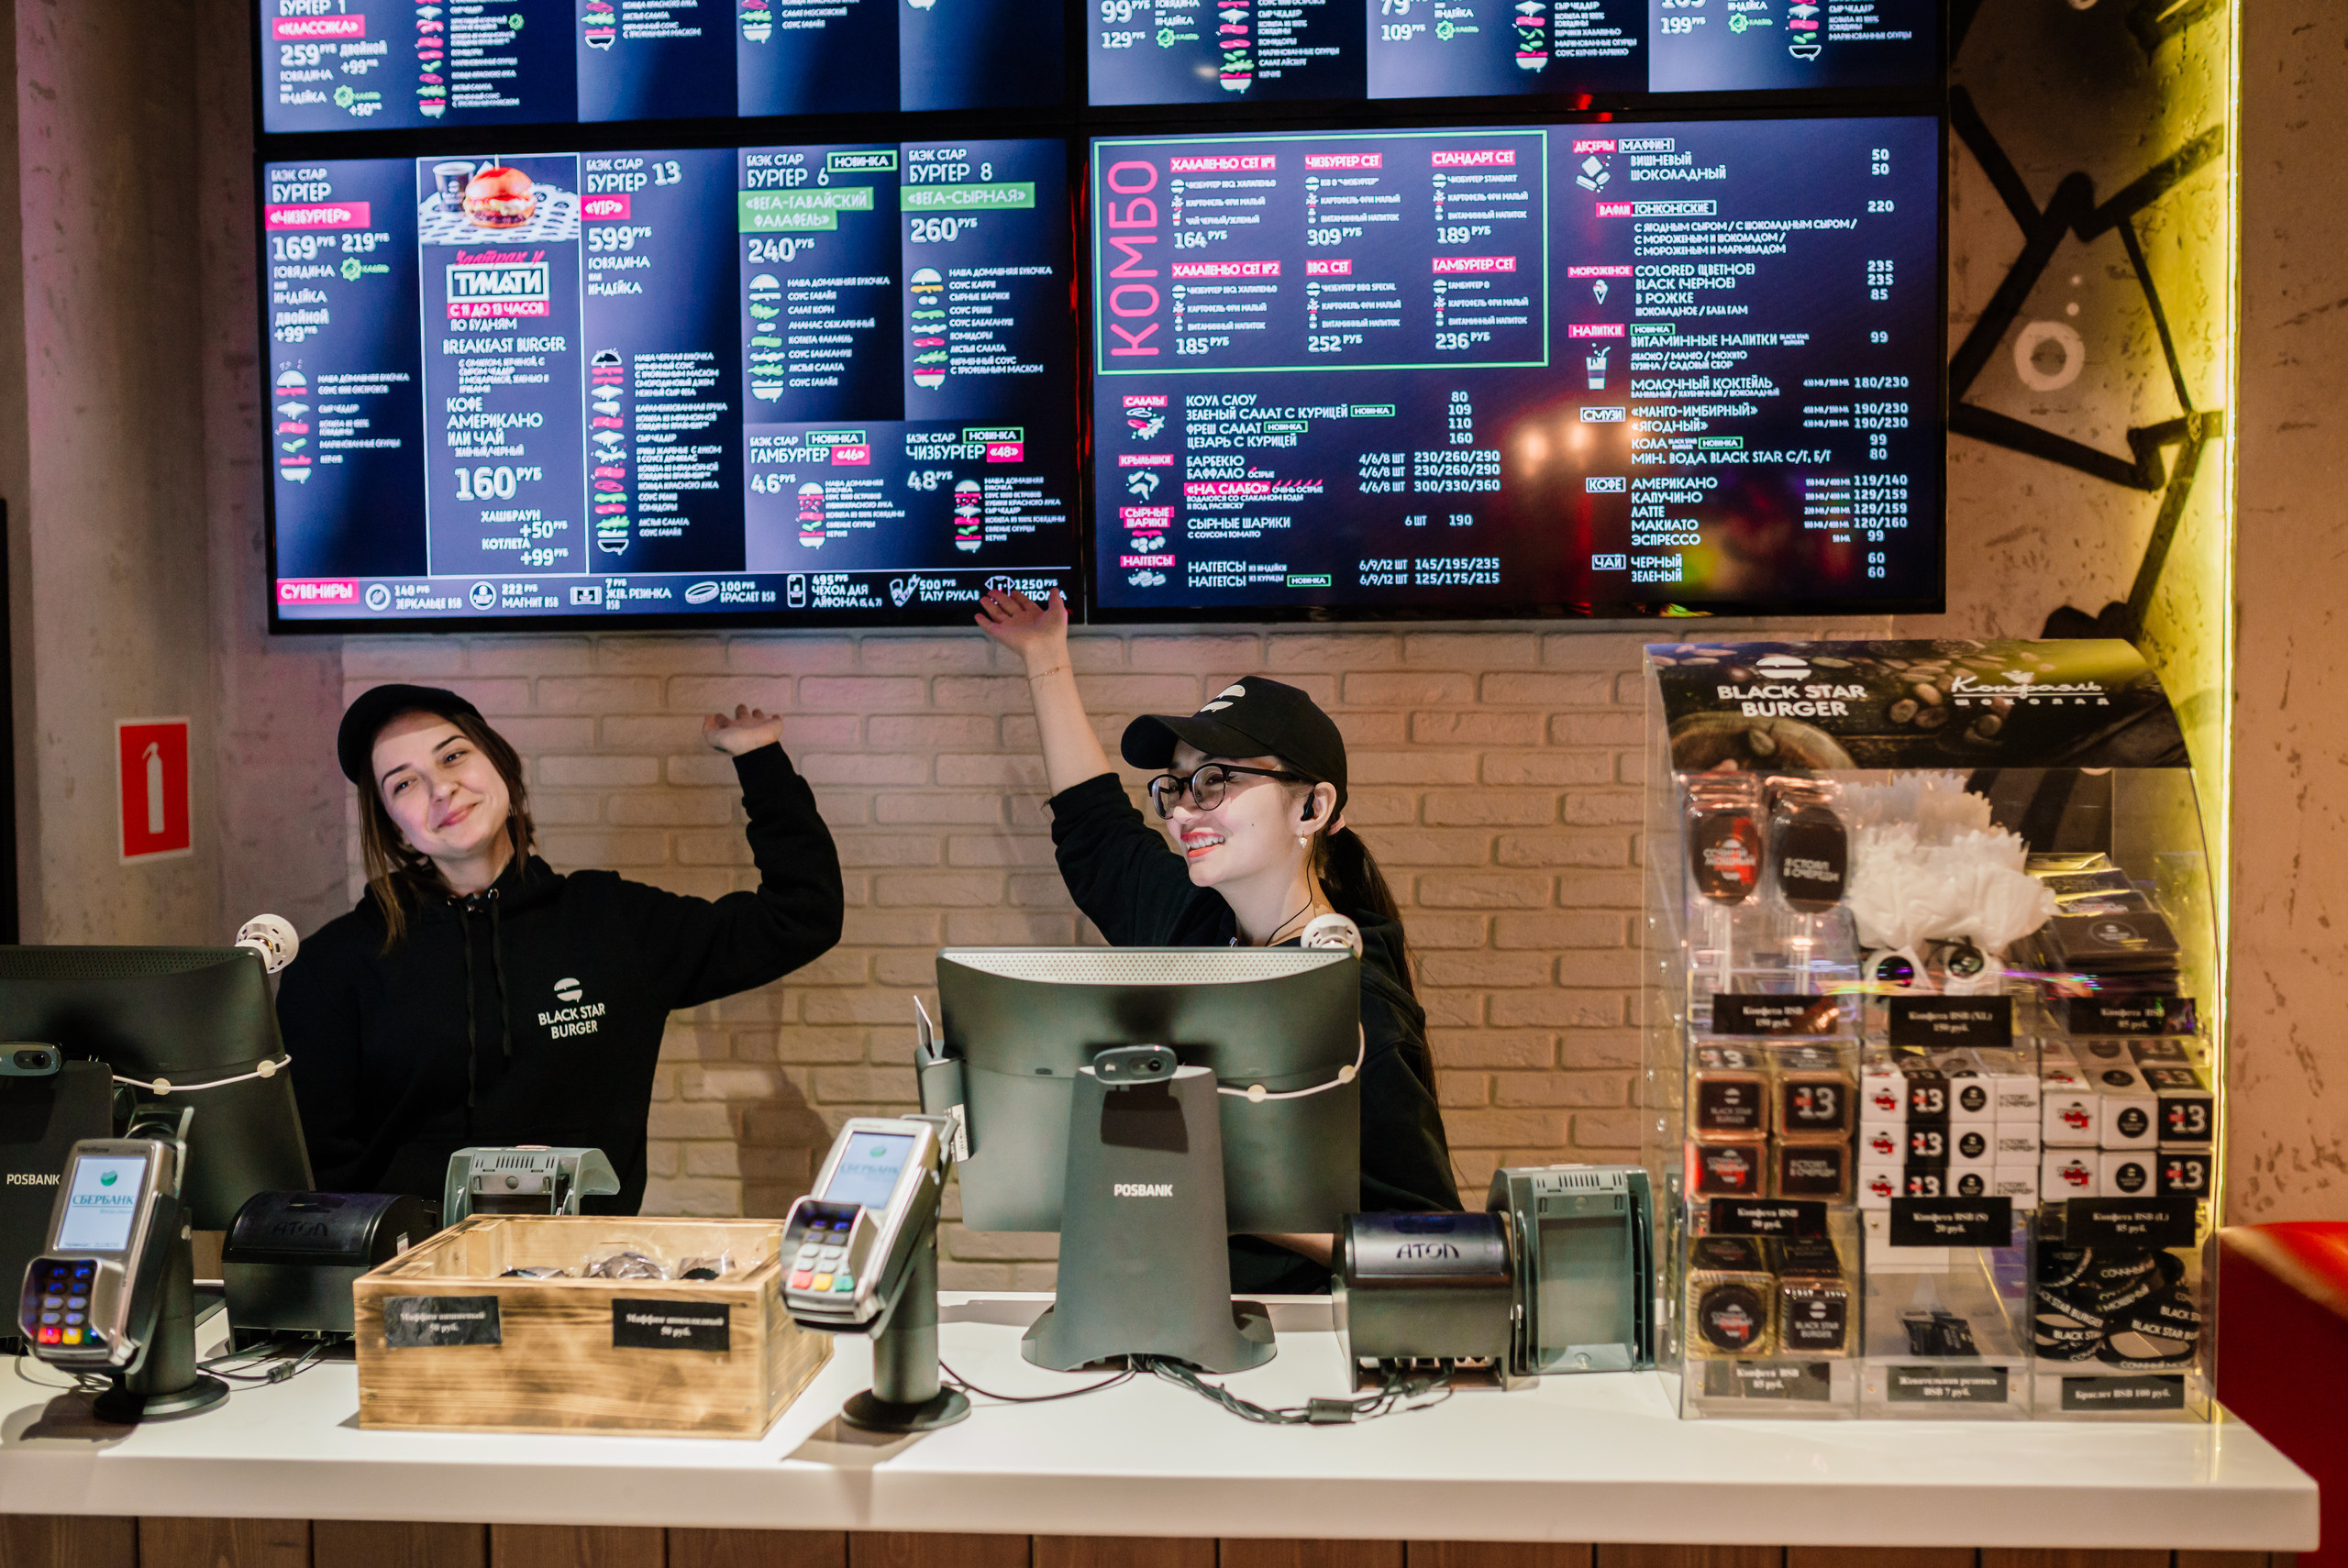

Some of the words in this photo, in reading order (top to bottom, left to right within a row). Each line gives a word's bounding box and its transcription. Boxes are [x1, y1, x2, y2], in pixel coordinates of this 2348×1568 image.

[278, 22, 359, 38] «КЛАССИКА»
[1621, 140, 1670, 151] МАФФИН
[774, 153, 804, 166] СТАР
[936, 149, 968, 160] СТАР
[1305, 154, 1359, 168] ЧИЗБУРГЕР
[1361, 154, 1380, 166] СЕТ
[1433, 151, 1494, 165] СТАНДАРТ
[1496, 150, 1515, 162] СЕТ
[1630, 150, 1692, 167] ВИШНЕВЫЙ
[1872, 149, 1890, 161] 50
[835, 156, 889, 168] НОВИНКА
[587, 172, 648, 193] БУРГЕР
[652, 160, 682, 186] 13
[909, 163, 971, 182] БУРГЕР
[980, 162, 993, 182] 8
[1630, 164, 1727, 182] ШОКОЛАДНЫЙ
[1872, 163, 1890, 176] 50
[748, 168, 808, 188] БУРГЕР
[817, 167, 830, 186] 6
[272, 182, 331, 203] БУРГЕР
[908, 188, 1026, 205] «ВЕГА-СЫРНАЯ»
[585, 200, 623, 215] «VIP»
[746, 191, 867, 210] «ВЕГА-ГАВАЙСКИЙ
[1867, 200, 1895, 213] 220
[271, 208, 351, 225] «ЧИЗБУРГЕР»
[754, 212, 830, 228] ФАЛАФЕЛЬ»
[1107, 160, 1160, 356] КОМБО
[1434, 258, 1494, 271] ГАМБУРГЕР
[1496, 258, 1514, 270] СЕТ
[1634, 264, 1695, 277] COLORED
[1867, 259, 1894, 272] 235
[454, 271, 541, 295] ТИМАТИ
[1634, 279, 1676, 291] BLACK
[1867, 273, 1894, 286] 235
[588, 280, 642, 296] ИНДЕЙКА
[1870, 288, 1889, 301] 85
[1635, 293, 1643, 304] В
[1645, 292, 1694, 304] РОЖКЕ
[450, 304, 460, 316] С
[471, 304, 489, 317] ДО
[504, 302, 544, 315] ЧАСОВ
[450, 319, 466, 332] ПО
[469, 317, 517, 332] БУДНЯМ
[1573, 325, 1623, 337] НАПИТКИ
[1631, 336, 1718, 348] ВИТАМИННЫЕ
[1721, 334, 1778, 347] НАПИТКИ
[1870, 330, 1889, 344] 99
[443, 337, 514, 355] BREAKFAST
[516, 336, 566, 352] BURGER
[1631, 375, 1710, 391] МОЛОЧНЫЙ
[1712, 374, 1773, 390] КОКТЕЙЛЬ
[1854, 376, 1909, 389] 180/230
[1125, 396, 1165, 406] САЛАТЫ
[1186, 395, 1219, 406] КОУЛ
[1222, 394, 1257, 405] СЛОУ
[1451, 391, 1468, 403] 80
[447, 397, 482, 412] КОФЕ
[1448, 403, 1472, 415] 109
[1631, 402, 1758, 418] «МАНГО-ИМБИРНЫЙ»
[1854, 403, 1909, 415] 190/230
[1186, 406, 1237, 421] ЗЕЛЕНЫЙ
[1239, 408, 1282, 419] САЛАТ
[1285, 408, 1295, 418] С
[1298, 403, 1348, 420] КУРИЦЕЙ
[1583, 409, 1623, 421] СМУЗИ
[447, 413, 543, 429] АМЕРИКАНО
[1448, 417, 1472, 430] 110
[1631, 417, 1709, 434] «ЯГОДНЫЙ»
[969, 431, 1017, 441] НОВИНКА
[1186, 423, 1216, 435] ФРЕШ
[1219, 423, 1261, 434] САЛАТ
[448, 431, 471, 447] ИЛИ
[473, 427, 504, 446] ЧАЙ
[1187, 436, 1231, 449] ЦЕЗАРЬ
[1234, 436, 1244, 447] С
[1247, 433, 1297, 448] КУРИЦЕЙ
[1449, 432, 1473, 445] 160
[1632, 437, 1668, 450] КОЛА
[1869, 433, 1888, 447] 99
[750, 447, 830, 464] ГАМБУРГЕР
[836, 448, 865, 460] «46»
[905, 445, 986, 460] ЧИЗБУРГЕР
[990, 446, 1019, 458] «48»
[1358, 453, 1390, 466] 4/6/8
[1392, 453, 1405, 464] ШТ
[1413, 450, 1501, 464] 230/260/290
[1631, 453, 1667, 465] МИН.
[1669, 452, 1707, 466] ВОДА
[1711, 451, 1749, 464] BLACK
[1752, 450, 1783, 463] STAR
[1869, 447, 1888, 461] 80
[1186, 455, 1245, 467] БАРБЕКЮ
[1186, 468, 1245, 480] БАФФАЛО
[1413, 463, 1501, 478] 230/260/290
[1186, 483, 1216, 495] «НА
[1218, 482, 1269, 494] СЛАБО»
[1413, 479, 1501, 493] 300/330/360
[1589, 480, 1622, 491] КОФЕ
[1631, 477, 1718, 490] АМЕРИКАНО
[1854, 474, 1909, 487] 119/140
[1631, 491, 1703, 504] КАПУЧИНО
[1854, 488, 1908, 502] 129/159
[481, 509, 541, 522] ХАШБРАУН
[1631, 505, 1665, 518] ЛАТТЕ
[1854, 502, 1908, 515] 129/159
[1187, 518, 1240, 530] СЫРНЫЕ
[1242, 516, 1290, 528] ШАРИКИ
[1449, 514, 1473, 526] 190
[1631, 519, 1699, 532] МАКИАТО
[1854, 516, 1909, 529] 120/160
[482, 537, 531, 550] КОТЛЕТА
[1631, 533, 1701, 547] ЭСПРЕССО
[1867, 529, 1885, 542] 99
[1414, 558, 1501, 571] 145/195/235
[1594, 555, 1623, 569] ЧАЙ
[1631, 553, 1683, 569] ЧЕРНЫЙ
[1867, 552, 1886, 564] 60
[1414, 572, 1501, 586] 125/175/215
[1631, 568, 1683, 583] ЗЕЛЕНЫЙ
[1867, 566, 1886, 579] 60
[281, 584, 352, 599] СУВЕНИРЫ
[812, 583, 846, 596] ЧЕХОЛ
[847, 583, 868, 596] ДЛЯ
[920, 590, 946, 602] ТАТУ
[947, 589, 980, 601] РУКАВ
[502, 596, 543, 609] МАГНИТ
[720, 591, 760, 603] БРАСЛЕТ
[1717, 684, 1801, 701] BLACK
[1804, 682, 1867, 700] STAR
[1742, 701, 1850, 718] BURGER
[537, 1007, 579, 1026] BLACK
[580, 1002, 605, 1019] STAR
[551, 1020, 598, 1040] BURGER
[6, 1174, 61, 1186] POSBANK
[1113, 1184, 1173, 1198] POSBANK
[72, 1195, 135, 1206] СБЕРБАНК
[2132, 1319, 2160, 1335] BLACK
